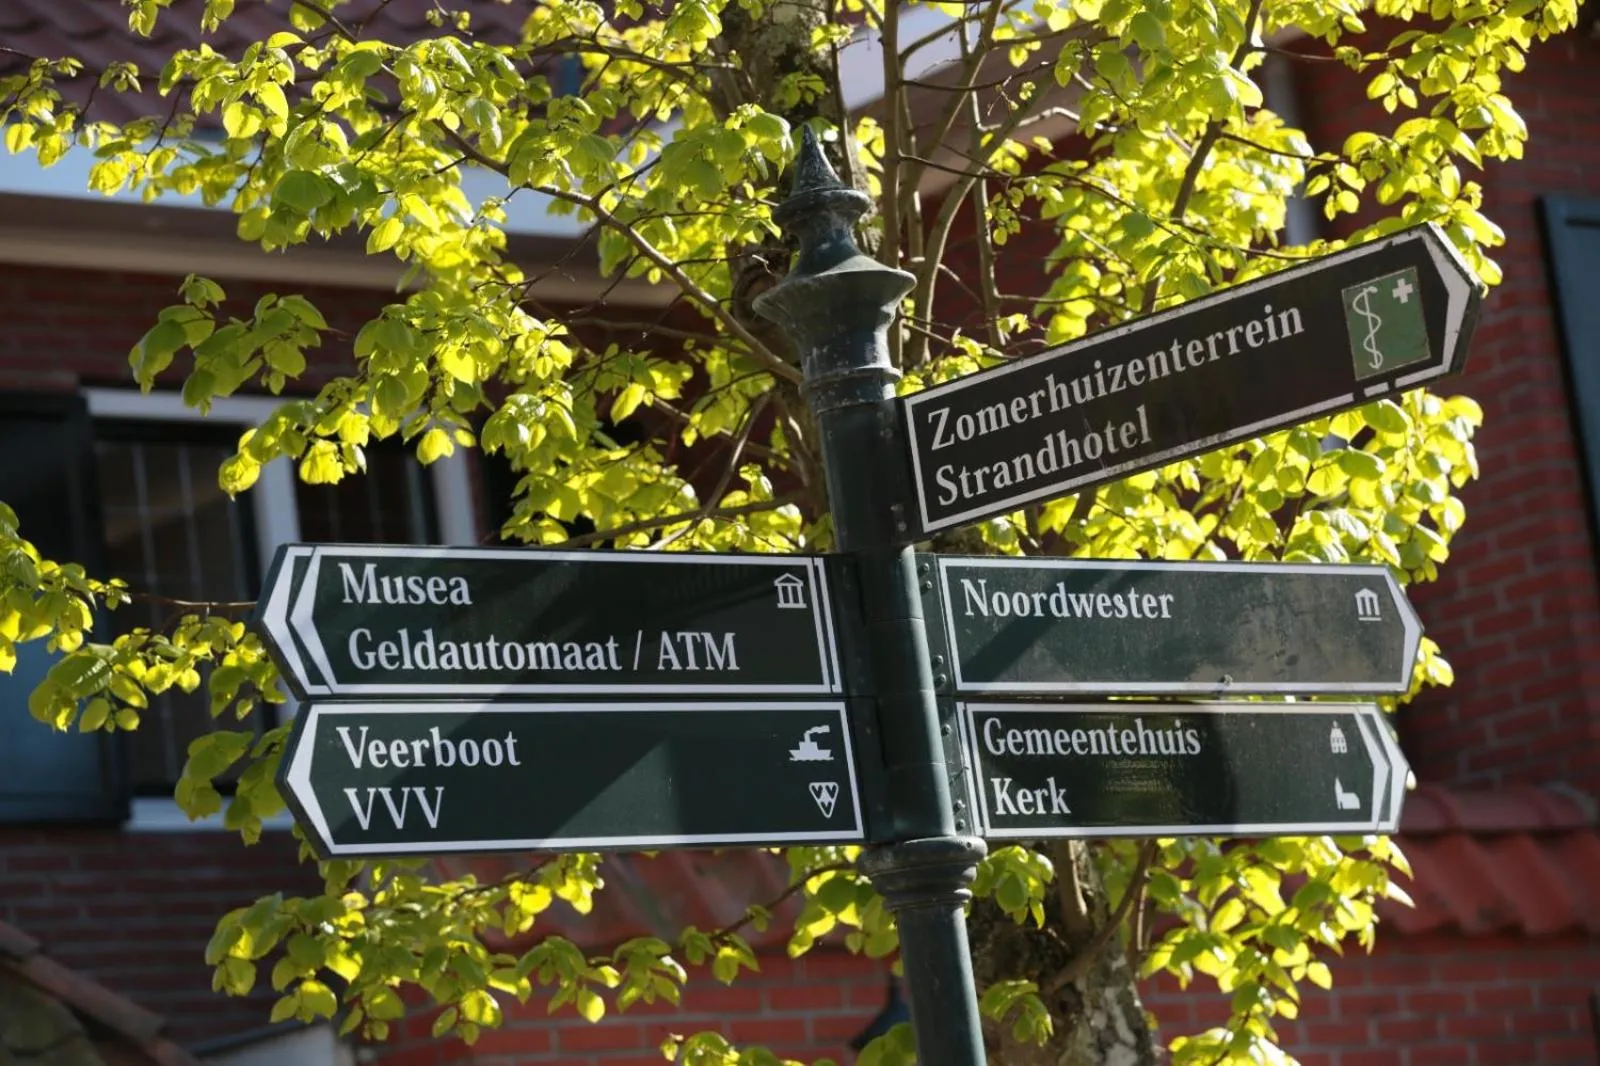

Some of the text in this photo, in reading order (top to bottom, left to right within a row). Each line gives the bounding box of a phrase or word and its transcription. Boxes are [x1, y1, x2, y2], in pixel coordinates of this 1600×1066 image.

[926, 303, 1306, 451] Zomerhuizenterrein
[936, 406, 1152, 506] Strandhotel
[338, 563, 473, 606] Musea
[961, 578, 1175, 620] Noordwester
[348, 628, 741, 672] Geldautomaat / ATM
[336, 726, 521, 769] Veerboot
[983, 717, 1202, 756] Gemeentehuis
[343, 787, 446, 830] VVV
[990, 777, 1072, 817] Kerk
